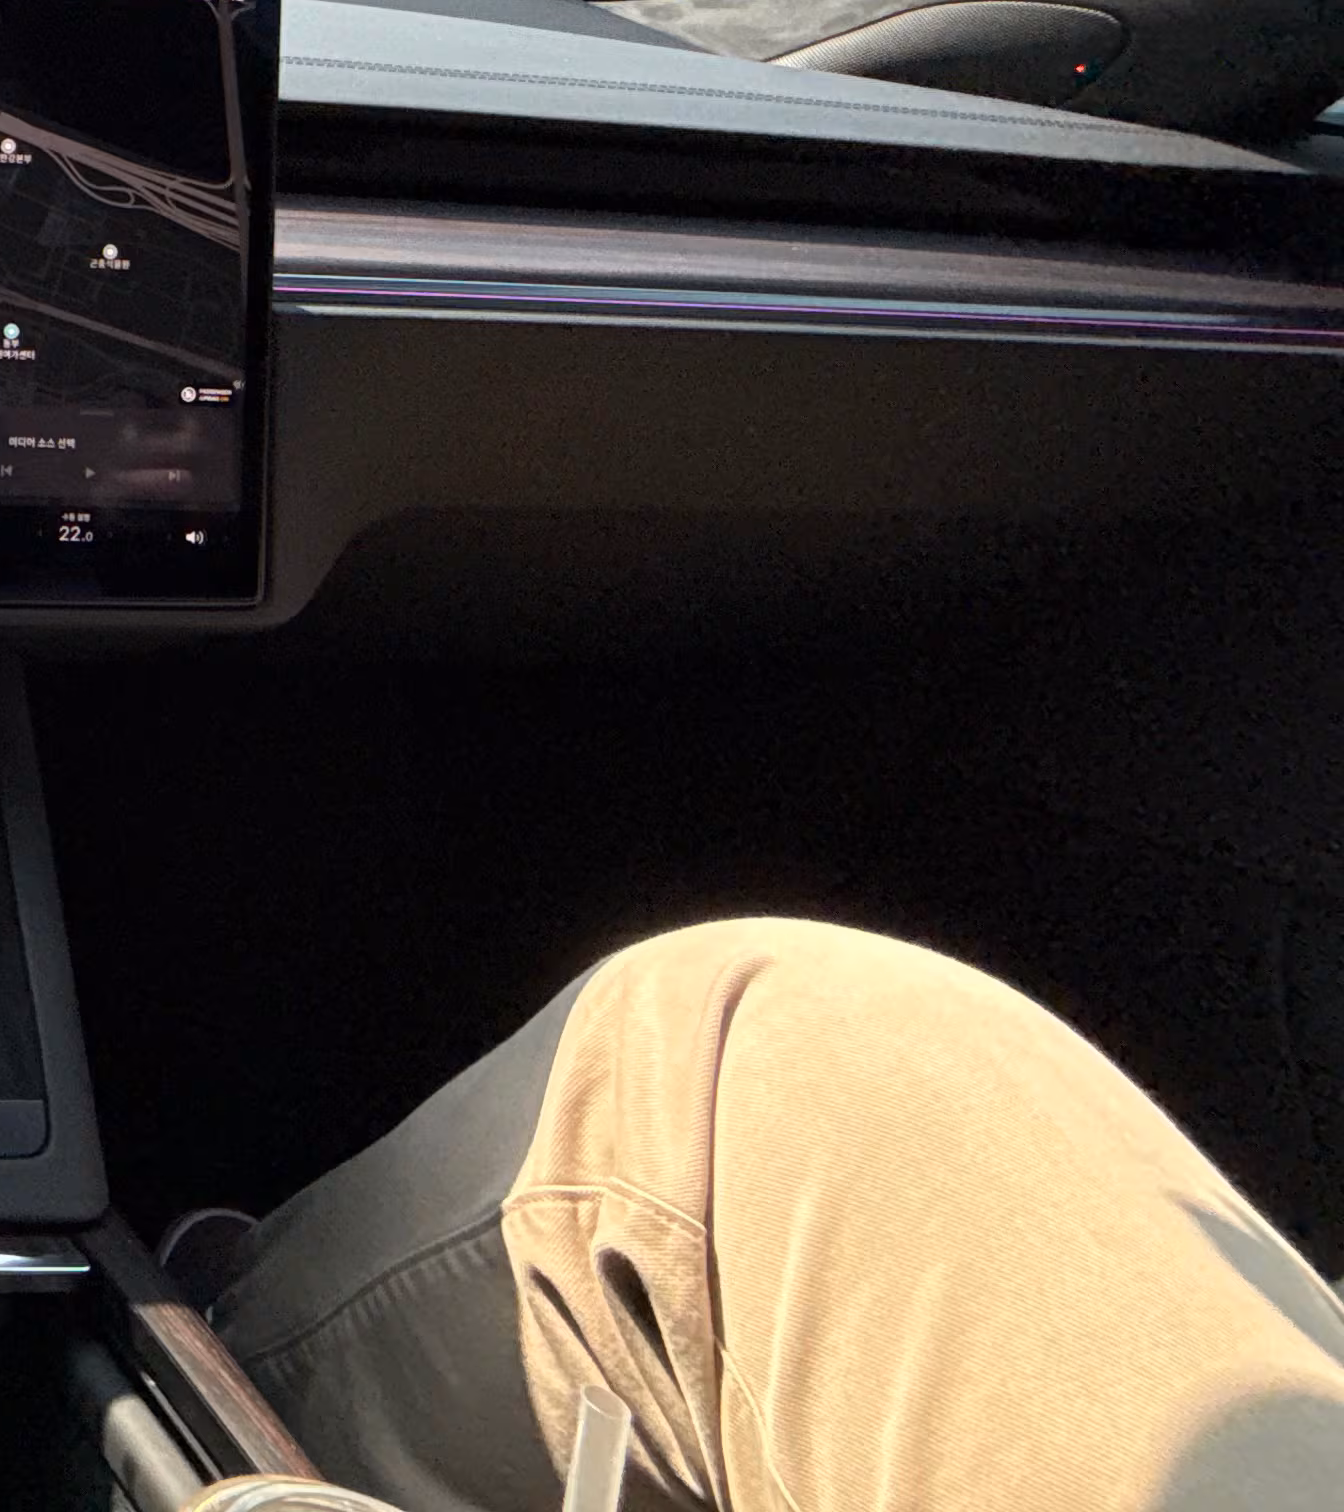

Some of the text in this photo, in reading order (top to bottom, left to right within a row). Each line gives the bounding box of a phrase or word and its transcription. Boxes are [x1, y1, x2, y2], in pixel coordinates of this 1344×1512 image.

[8, 436, 36, 449] 미디어
[58, 439, 76, 450] 선택
[58, 525, 94, 543] 22.0
